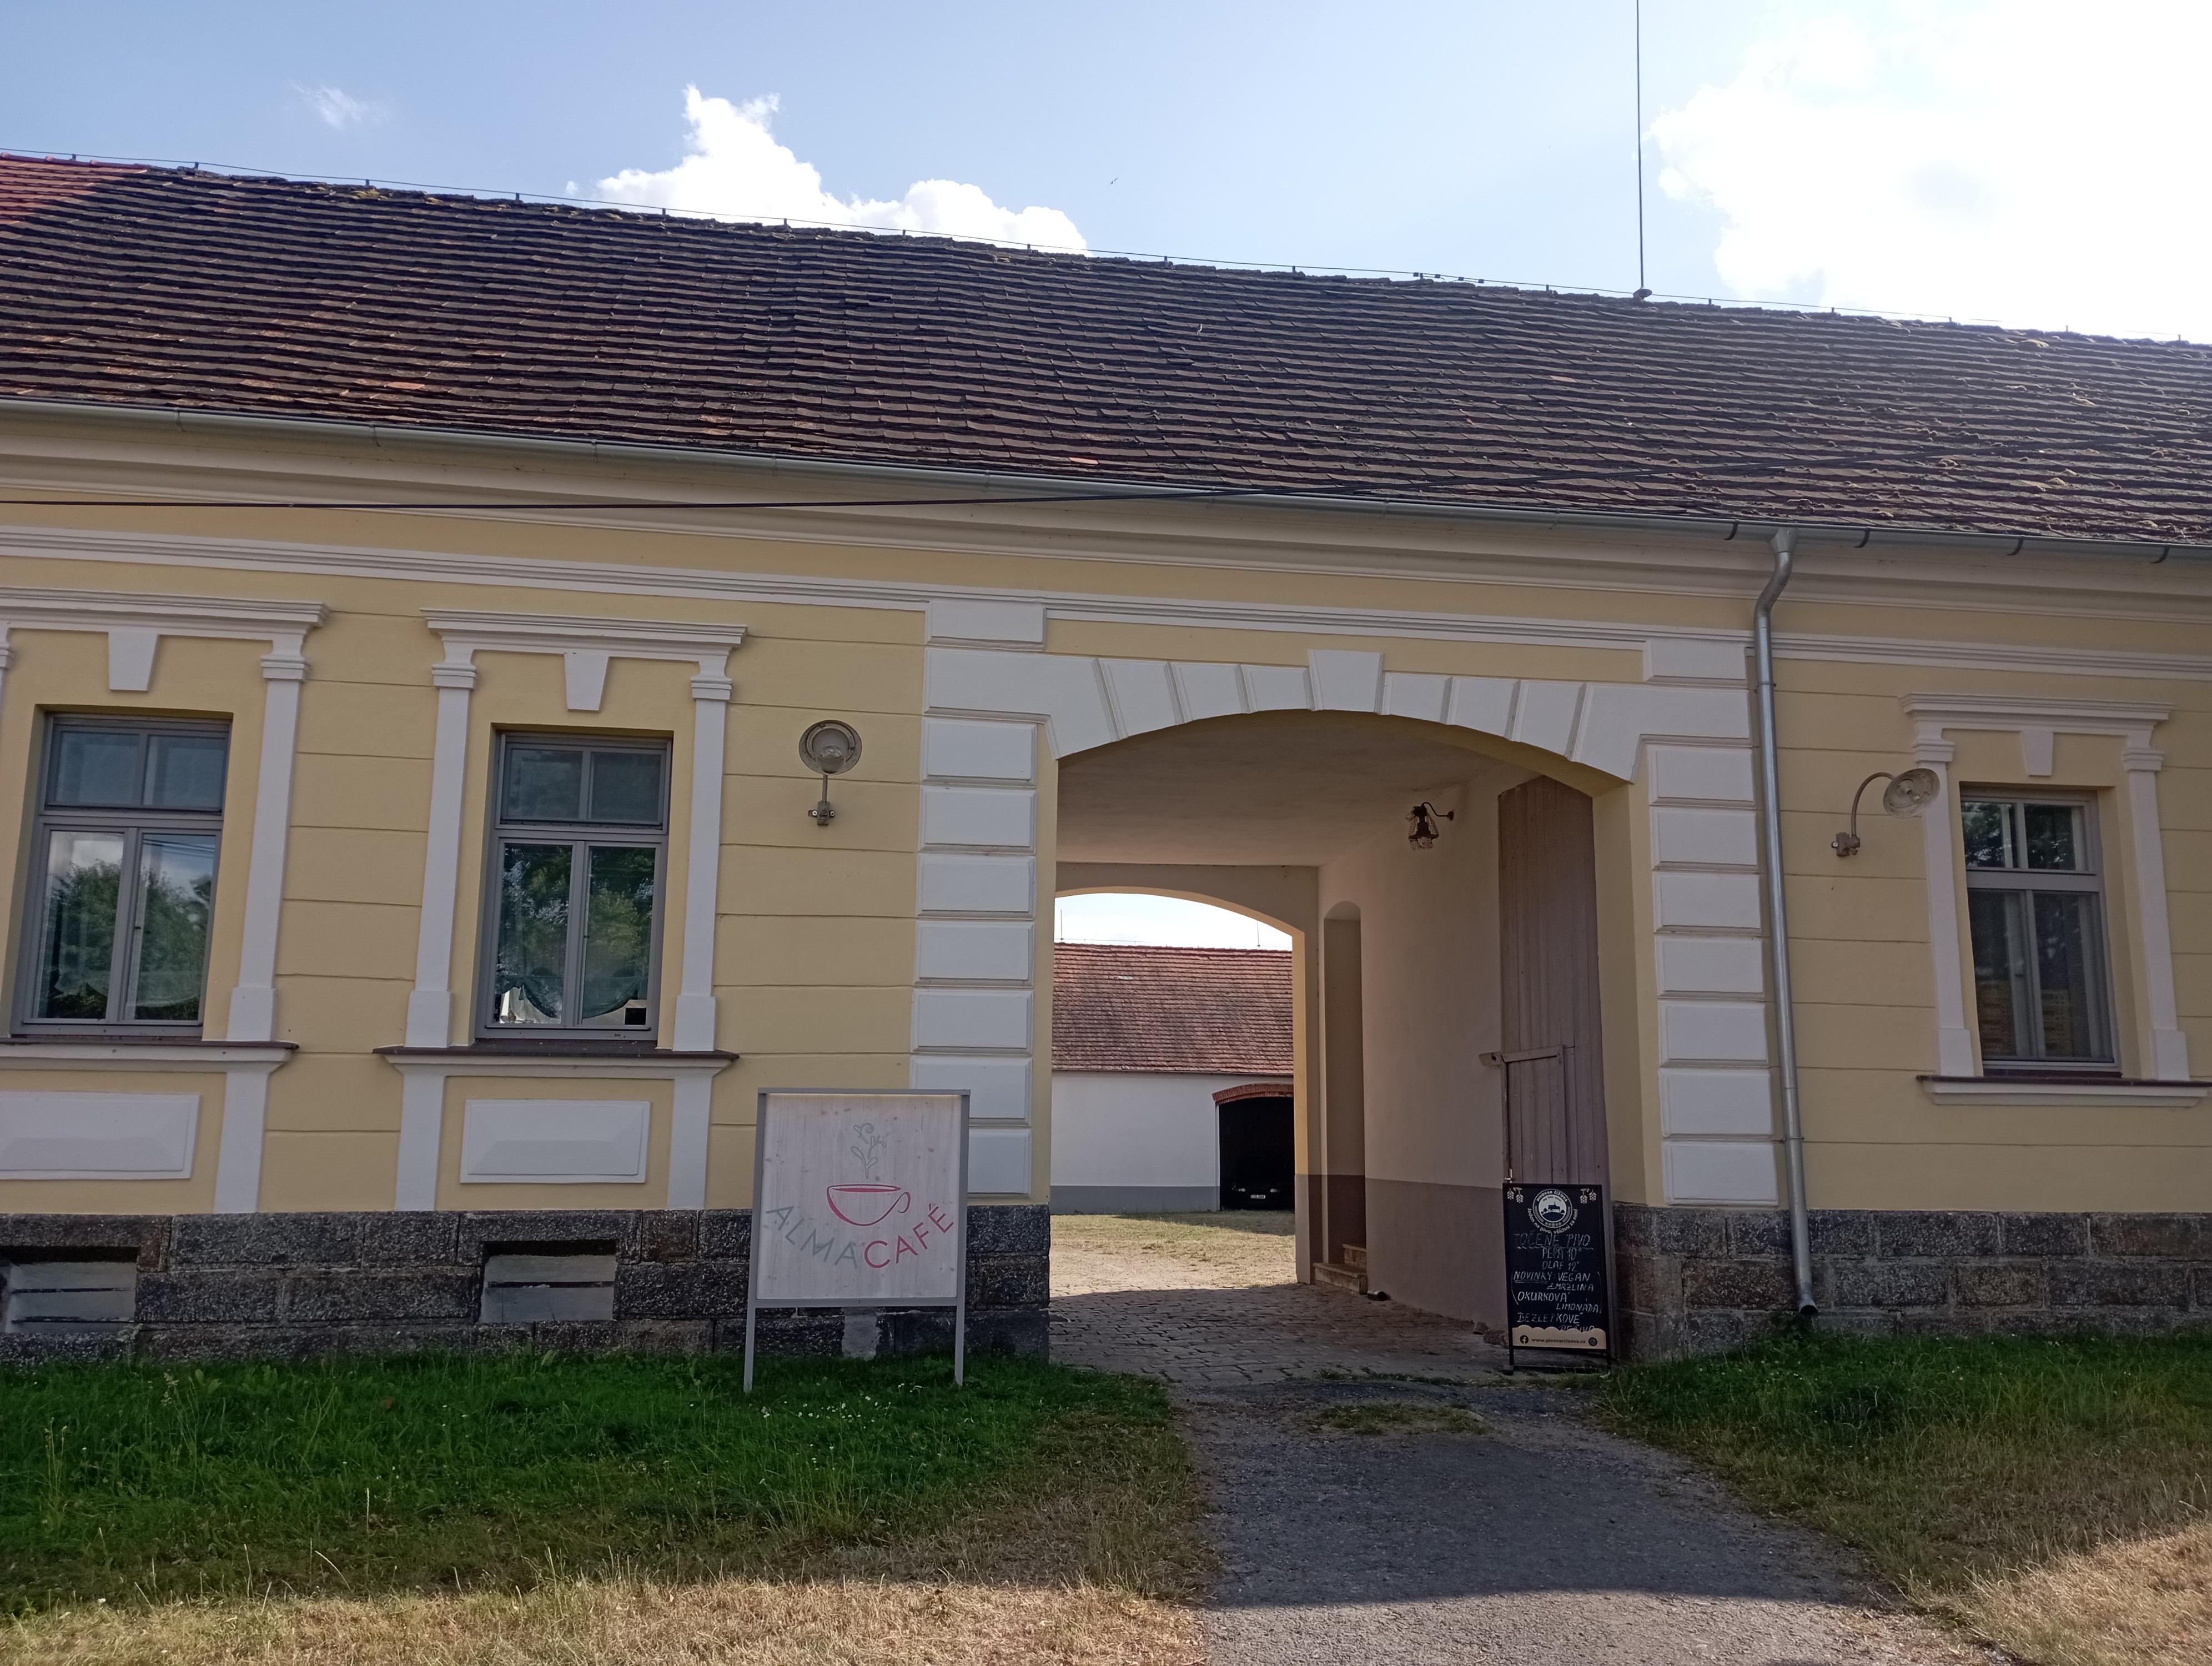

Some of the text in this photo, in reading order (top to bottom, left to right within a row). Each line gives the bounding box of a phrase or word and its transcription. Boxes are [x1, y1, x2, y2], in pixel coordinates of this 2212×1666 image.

[1536, 1190, 1553, 1202] PIVOVAR
[1566, 1234, 1591, 1247] PIVO
[1542, 1261, 1564, 1270] OLAF
[1558, 1272, 1591, 1282] VEGAN
[1517, 1291, 1570, 1302] OKURKOVÁ
